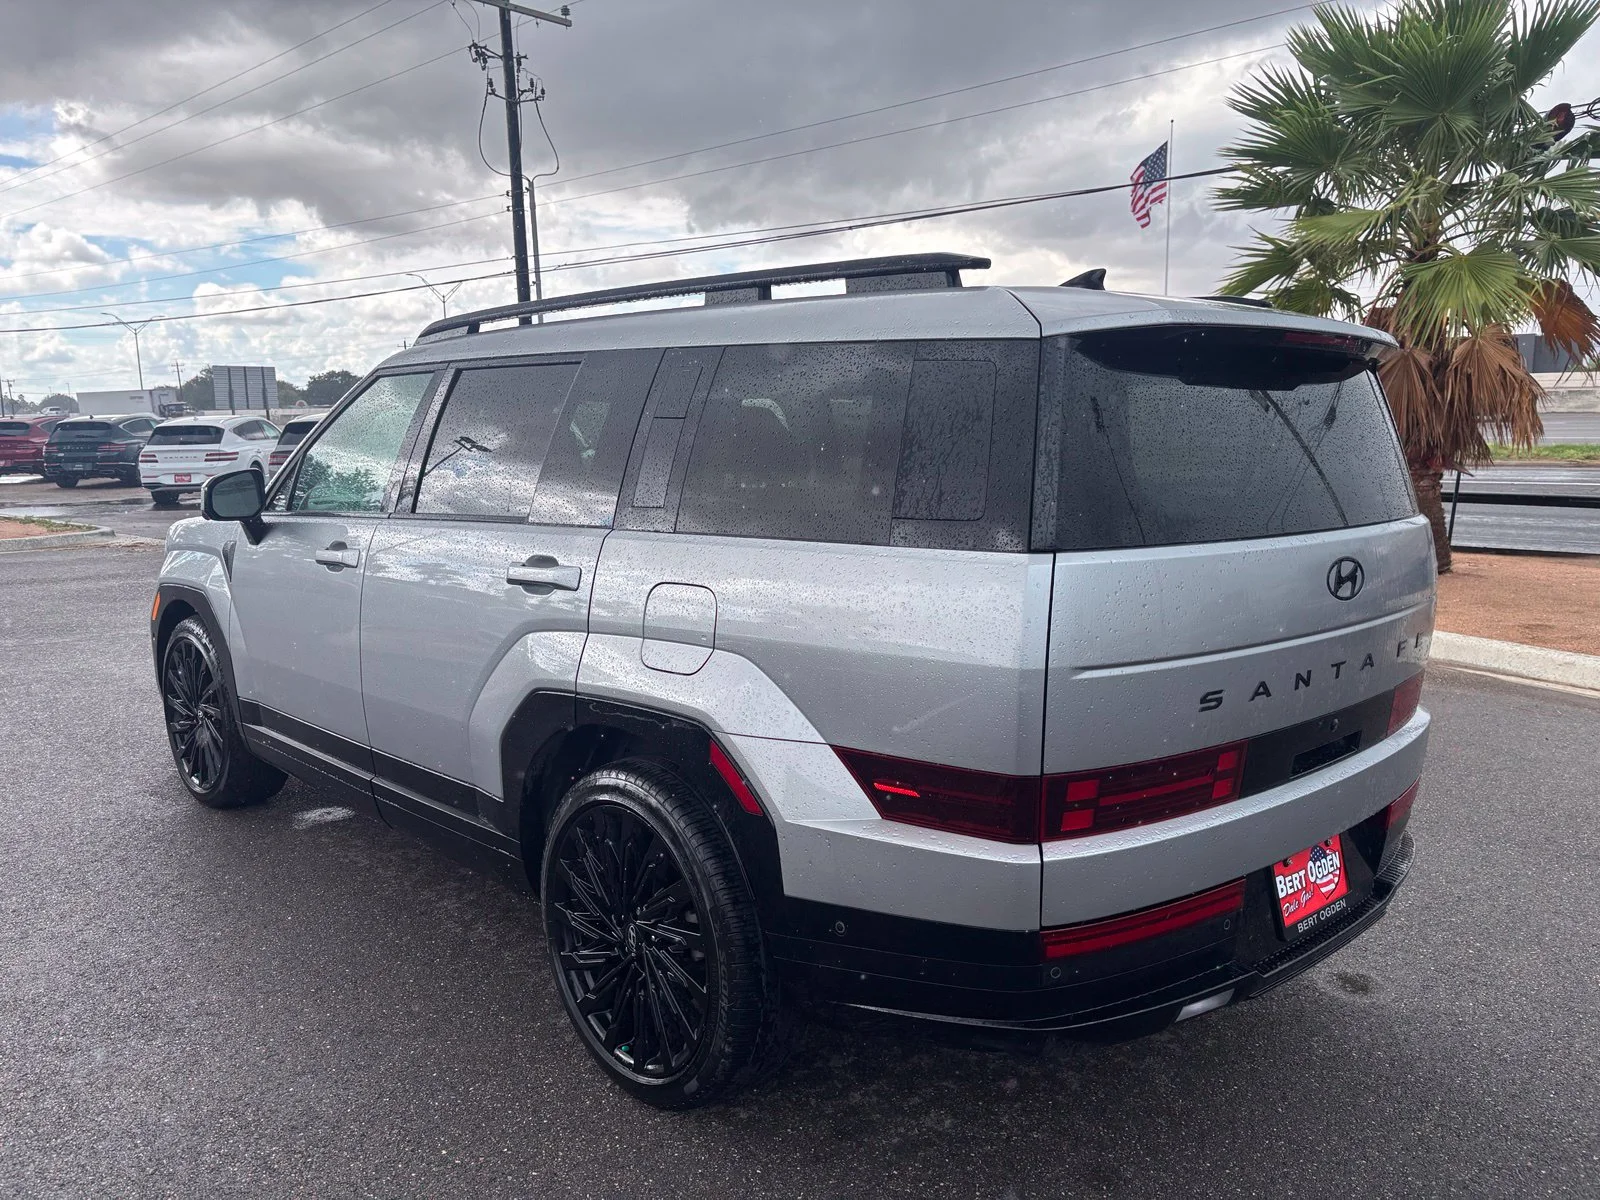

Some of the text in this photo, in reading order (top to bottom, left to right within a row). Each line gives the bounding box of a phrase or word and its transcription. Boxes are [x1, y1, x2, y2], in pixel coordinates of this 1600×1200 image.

[1198, 653, 1375, 712] SANTA
[1275, 851, 1341, 899] BERT OGDEN
[1297, 898, 1347, 933] BERT OGDEN
